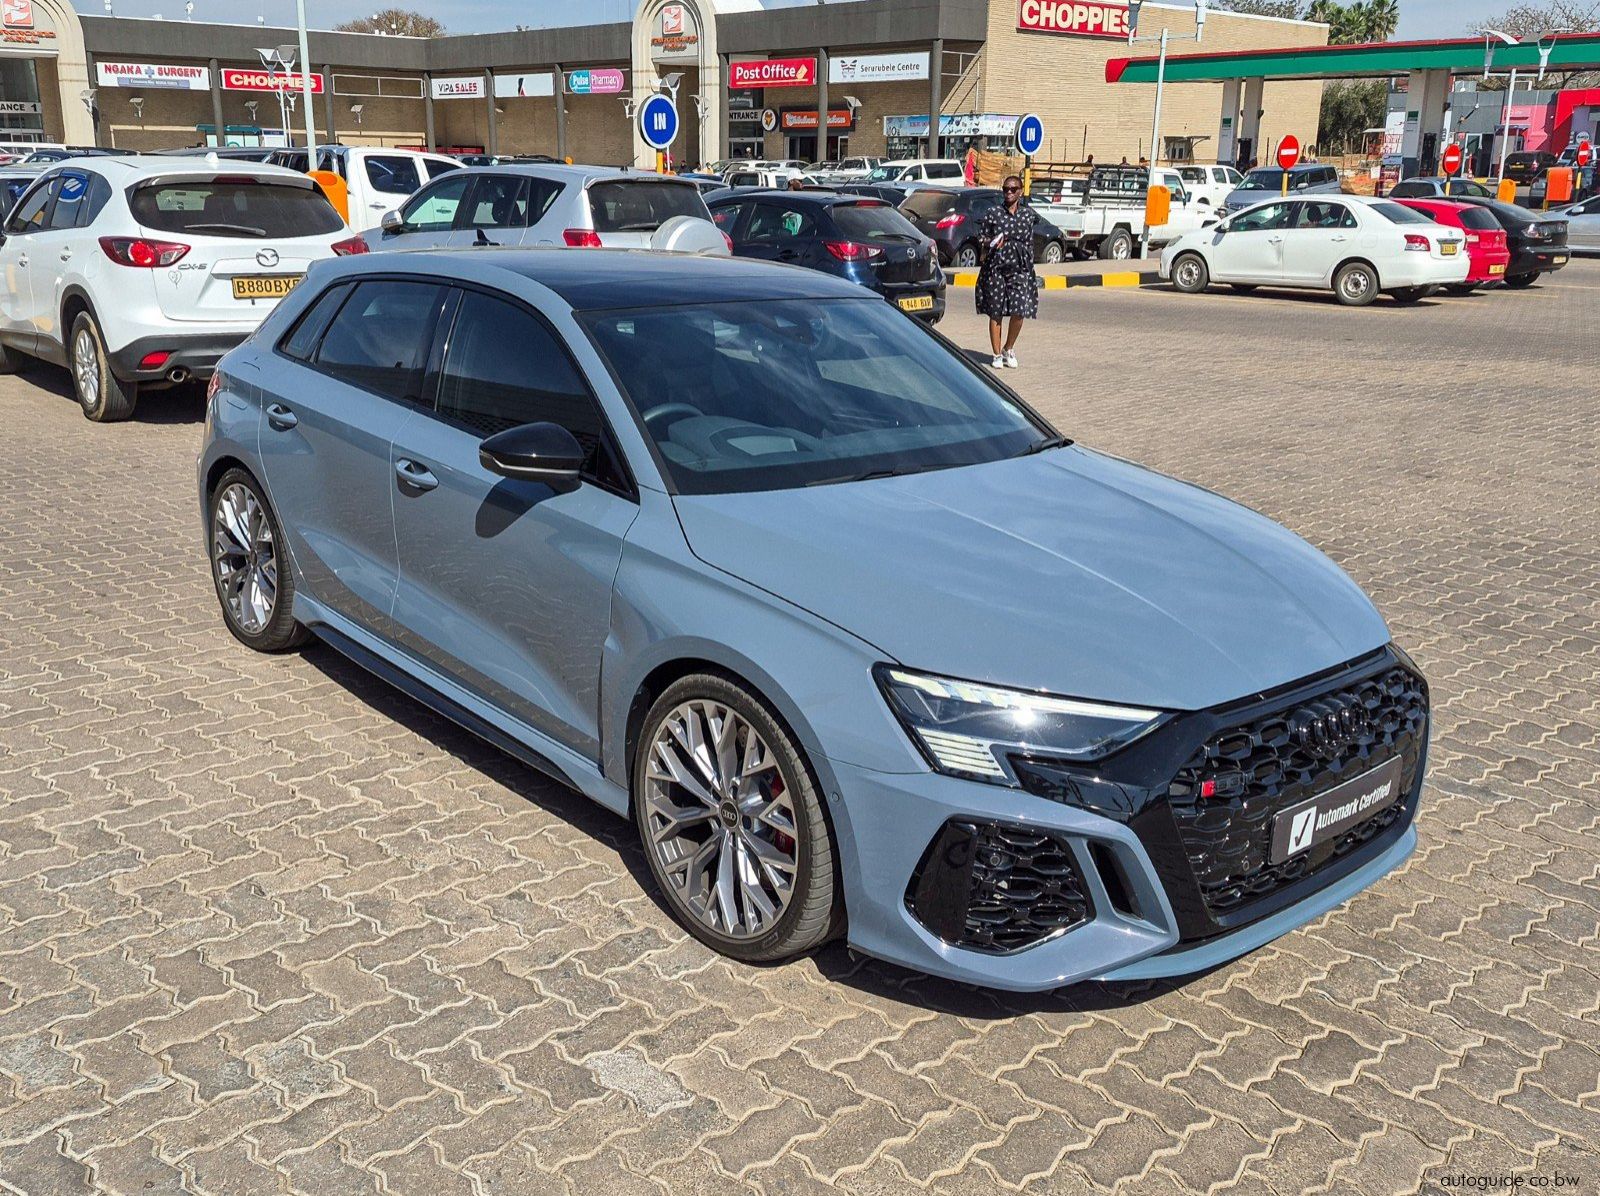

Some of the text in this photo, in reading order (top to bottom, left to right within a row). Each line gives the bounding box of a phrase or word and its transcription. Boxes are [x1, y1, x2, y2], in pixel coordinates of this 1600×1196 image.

[104, 64, 202, 78] NGAKA SURGERY
[736, 64, 796, 80] Post Office
[860, 62, 920, 73] Serurubele Centre
[455, 82, 478, 92] SALES
[572, 74, 620, 89] Pulse Pharmacy
[30, 103, 37, 112] 1
[653, 112, 667, 130] IN
[1026, 127, 1036, 142] IN
[1315, 779, 1392, 831] Automark Certified
